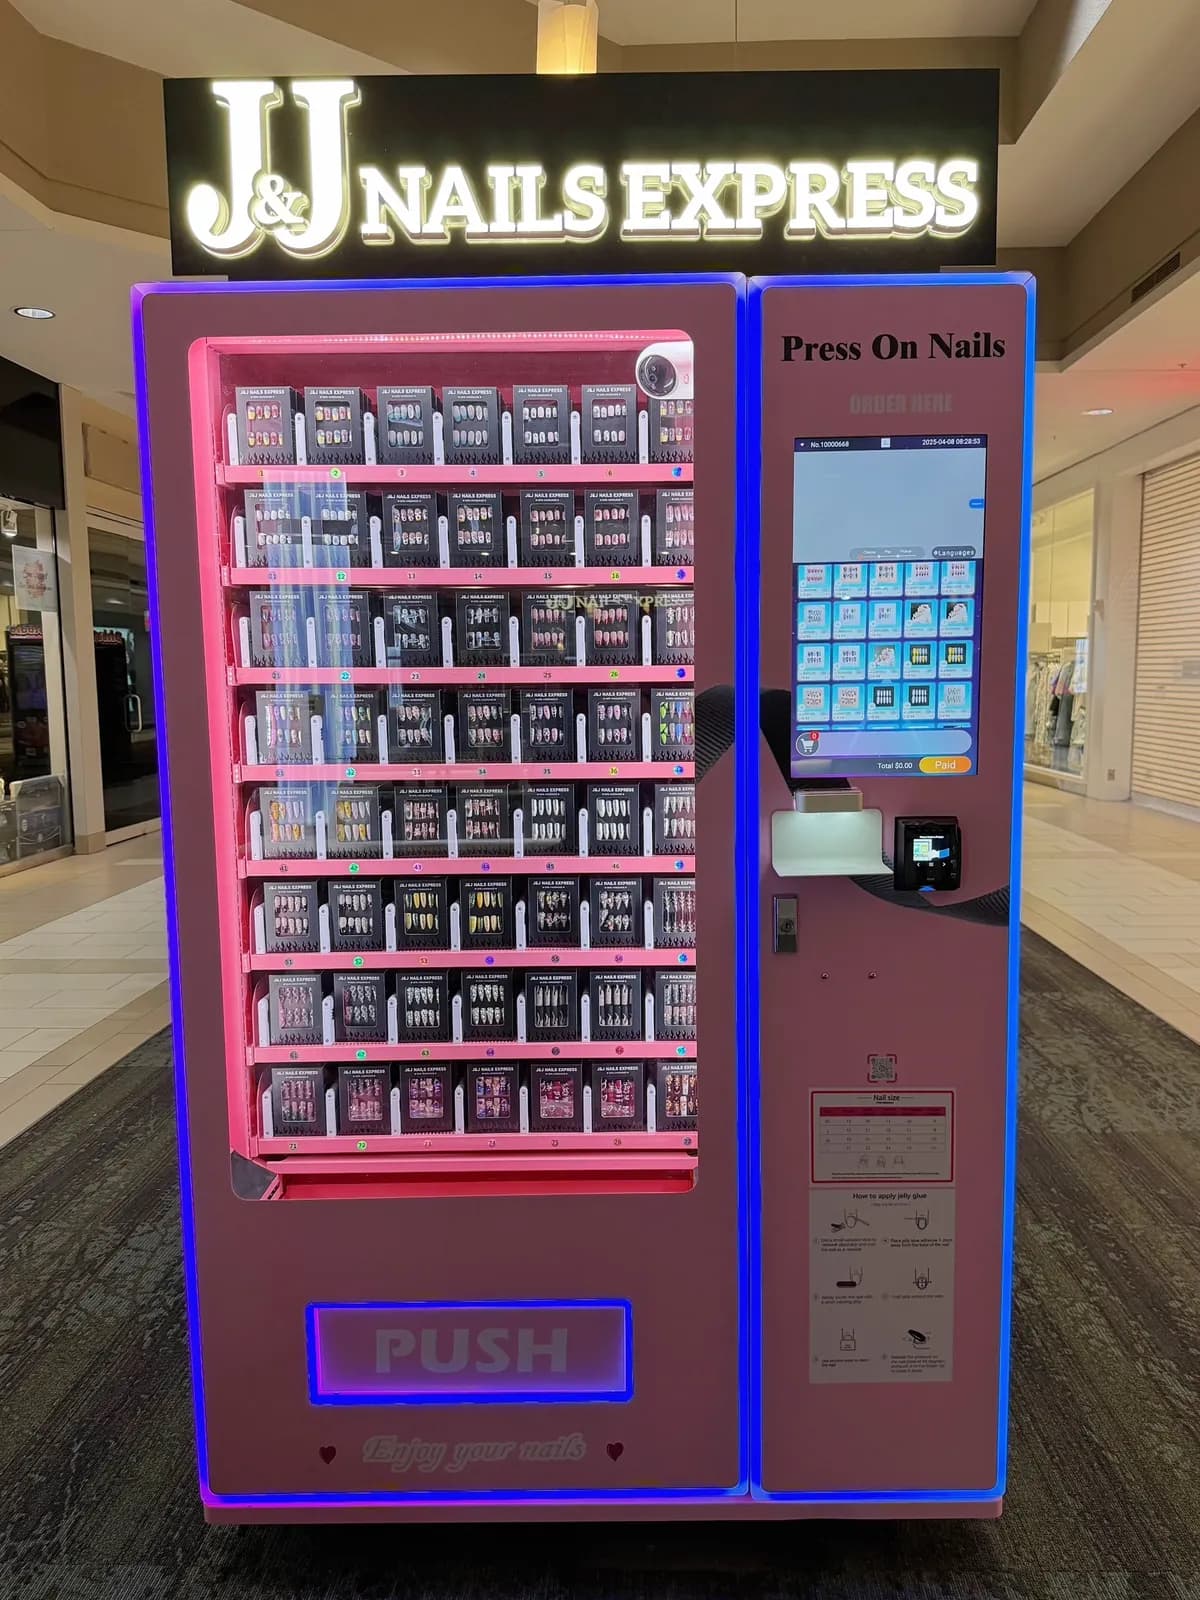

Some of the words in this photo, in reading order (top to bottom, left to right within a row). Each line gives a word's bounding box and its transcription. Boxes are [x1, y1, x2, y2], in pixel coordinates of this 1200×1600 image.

[186, 80, 360, 257] J&J
[361, 165, 604, 244] NAILS
[620, 160, 980, 242] EXPRESS
[781, 335, 861, 362] Press
[872, 333, 918, 360] On
[928, 331, 1006, 359] Nails
[850, 393, 906, 415] ORDER
[911, 393, 953, 413] HERE
[894, 762, 913, 770] $0.00
[935, 760, 956, 770] Paid
[873, 1094, 887, 1102] Nail
[375, 1328, 568, 1373] PUSH
[362, 1435, 448, 1473] Enjoy
[445, 1441, 516, 1473] your
[520, 1432, 587, 1461] nails
